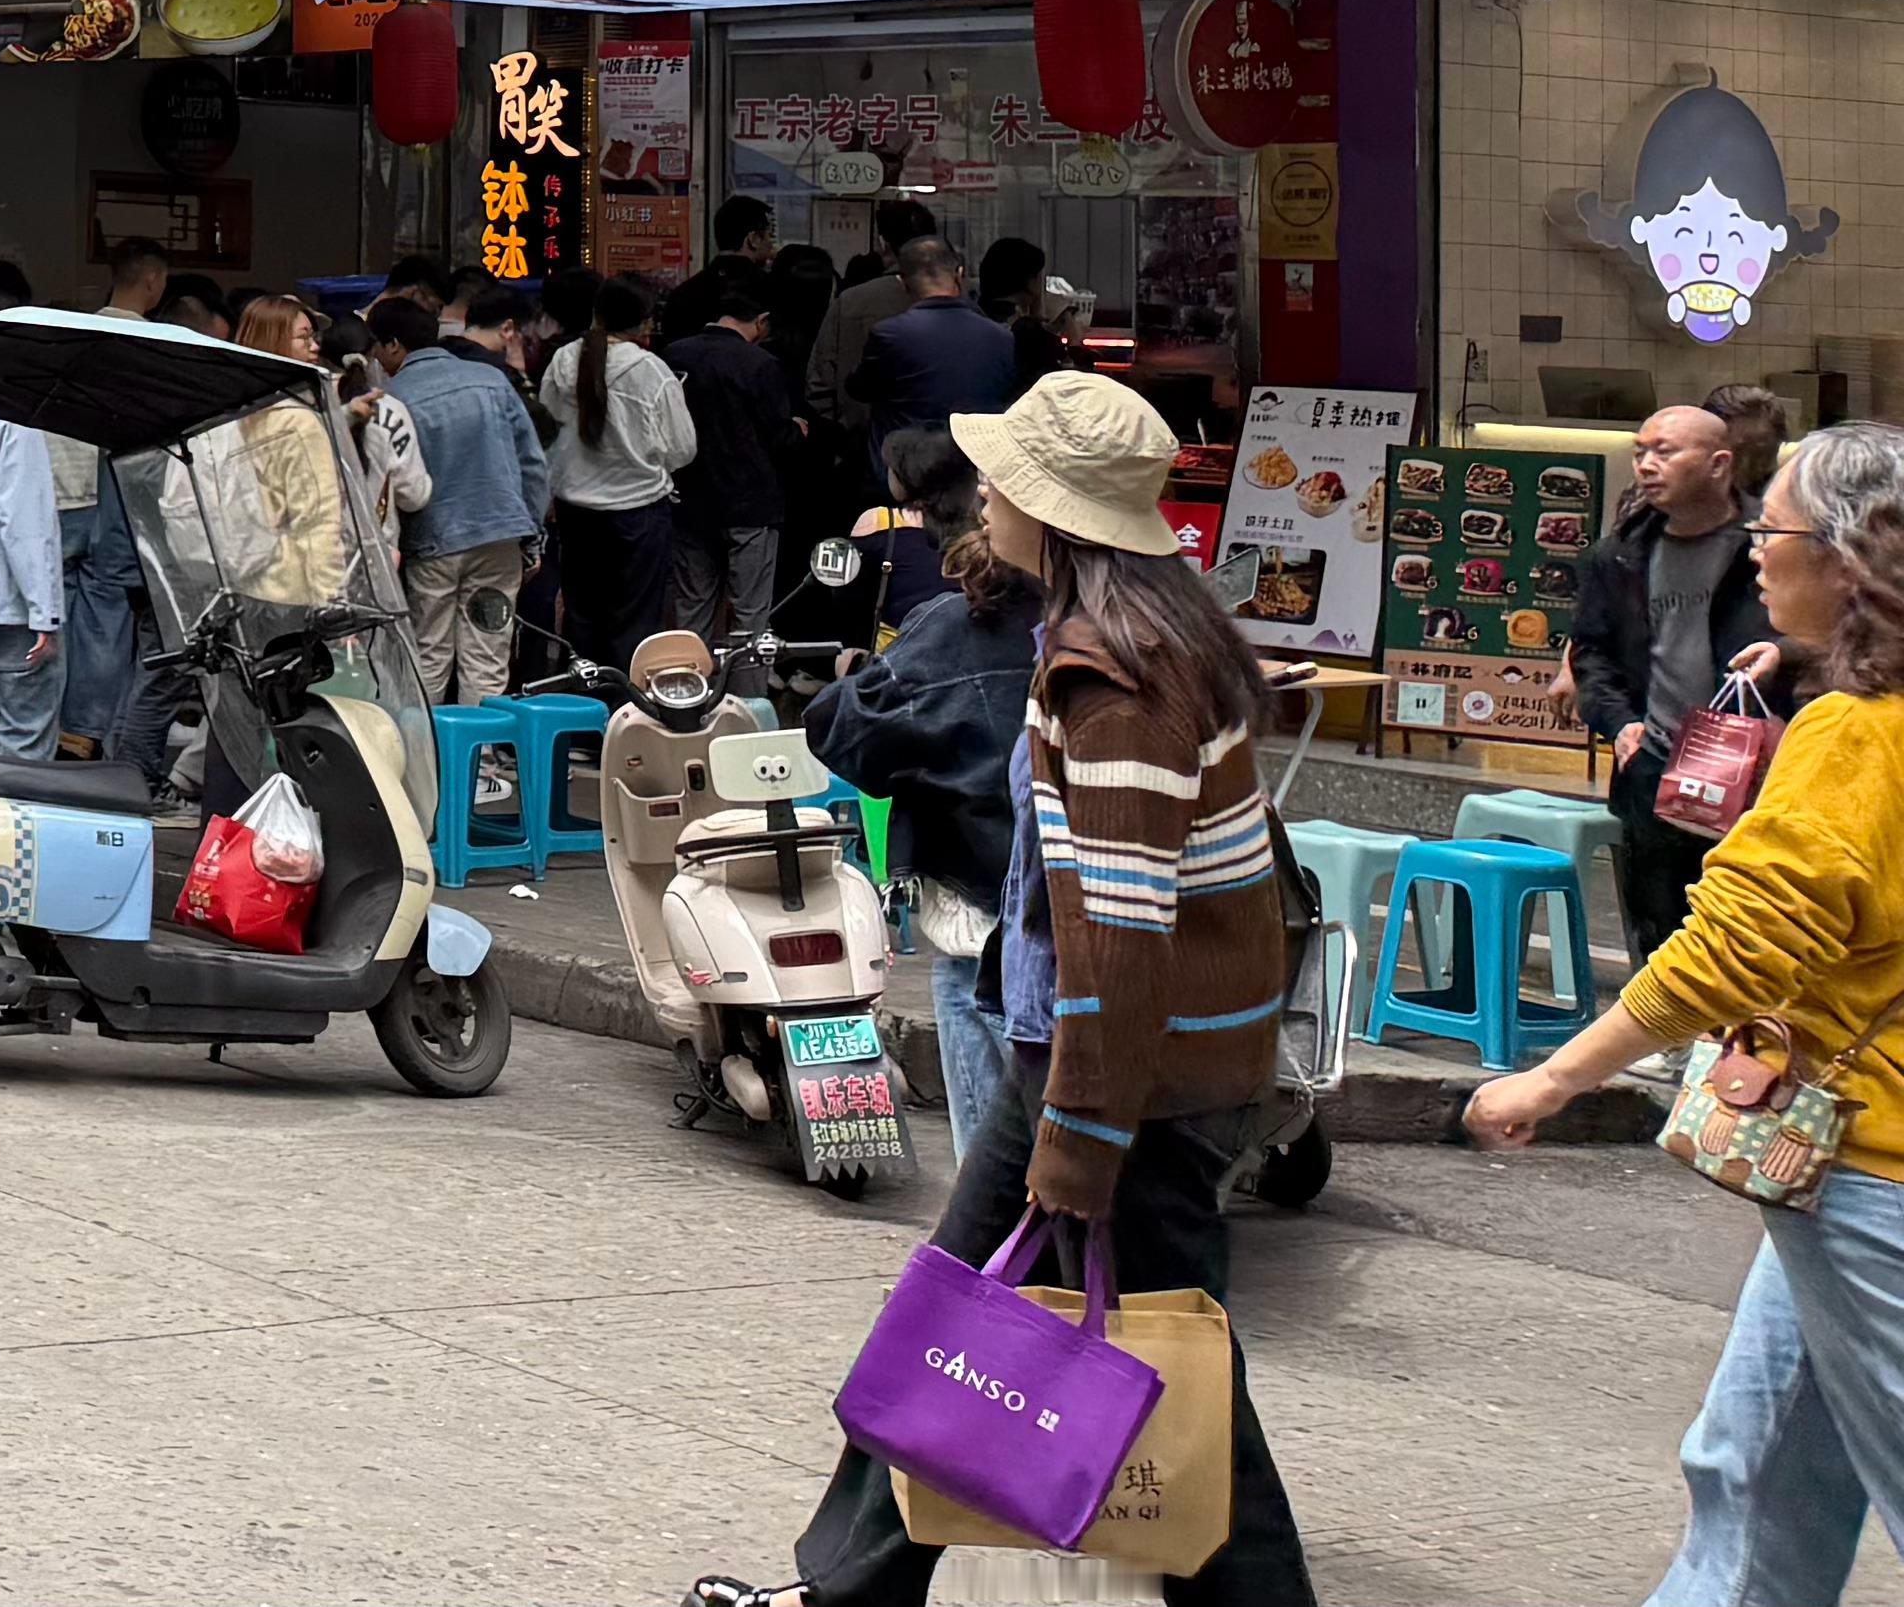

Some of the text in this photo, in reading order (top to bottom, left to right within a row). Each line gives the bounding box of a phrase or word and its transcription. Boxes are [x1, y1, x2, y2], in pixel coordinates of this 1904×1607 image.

[735, 93, 942, 145] 正宗老字号
[990, 93, 1174, 146] 朱三皮
[544, 174, 561, 274] 传承乐
[800, 1036, 873, 1062] AE4356
[924, 1346, 1026, 1413] GANSO
[1125, 1460, 1163, 1496] 琪
